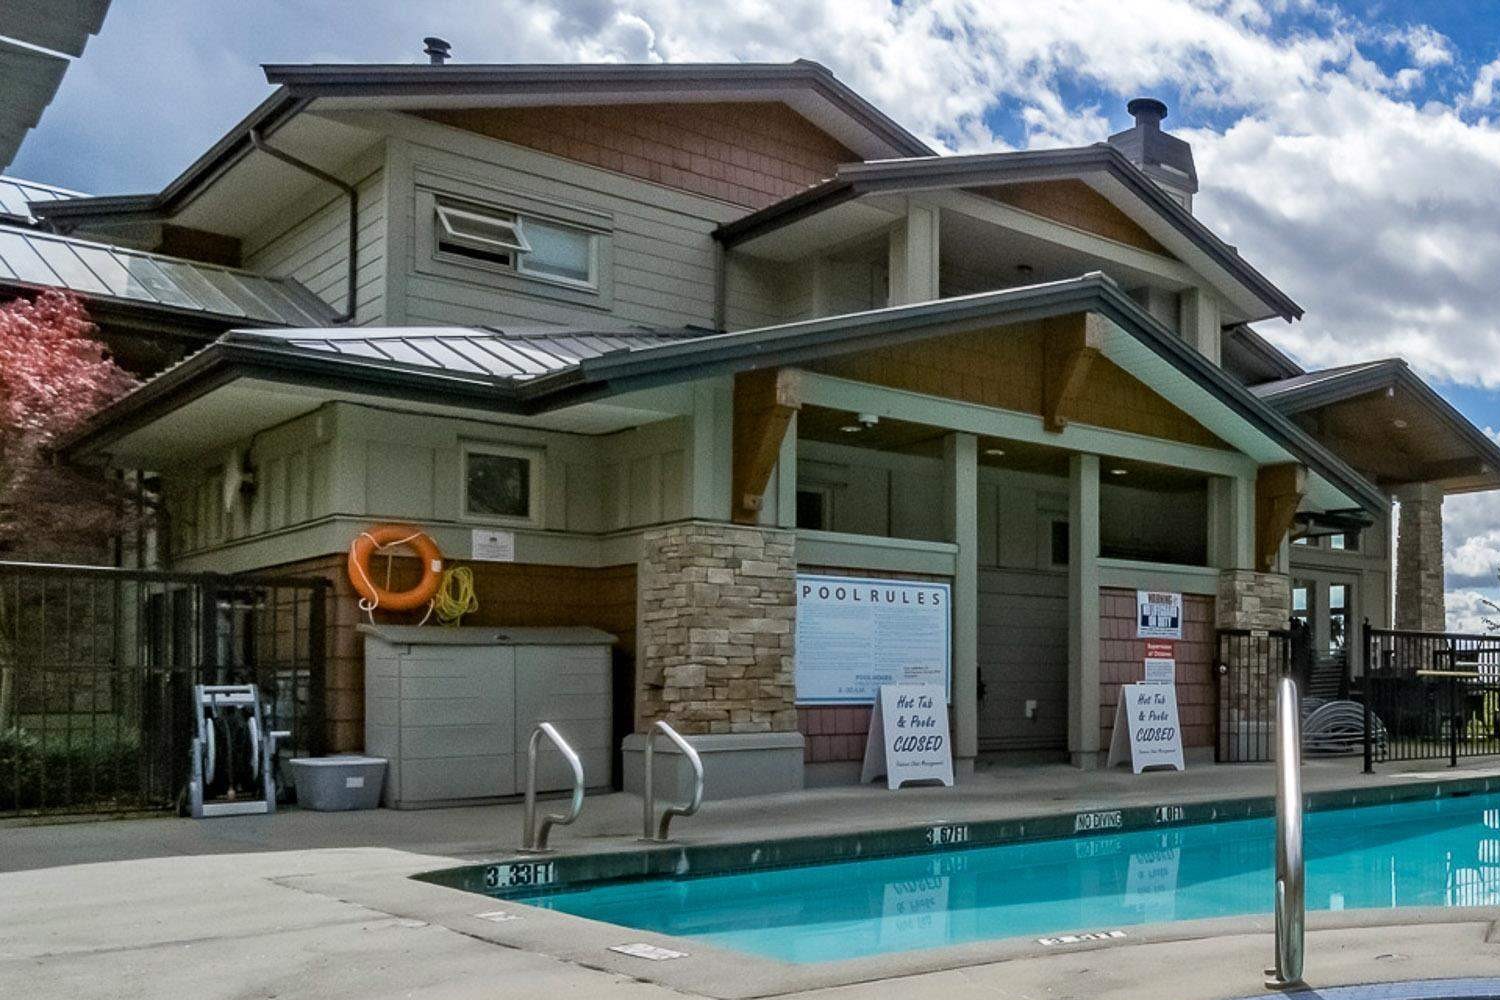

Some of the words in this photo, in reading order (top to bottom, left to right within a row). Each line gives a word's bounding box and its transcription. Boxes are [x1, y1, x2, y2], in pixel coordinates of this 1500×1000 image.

[896, 694, 914, 709] Hot
[918, 694, 934, 709] Tub
[1137, 693, 1151, 705] Hot
[1154, 693, 1166, 705] Tub
[896, 715, 907, 728] &
[910, 714, 937, 728] Pools
[1138, 710, 1145, 721] &
[1136, 727, 1175, 742] CLOSED
[893, 735, 943, 752] CLOSED
[1093, 811, 1121, 828] DIVING
[486, 862, 552, 887] 3.33FT
